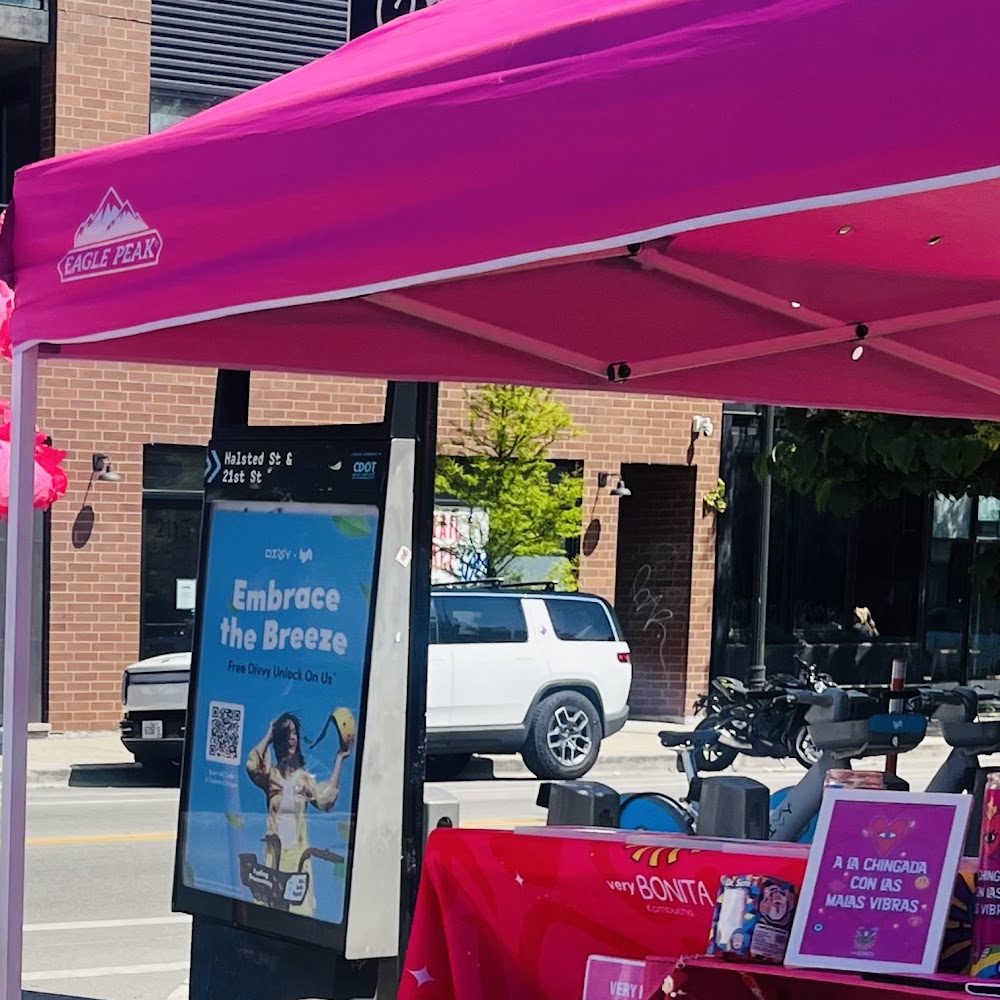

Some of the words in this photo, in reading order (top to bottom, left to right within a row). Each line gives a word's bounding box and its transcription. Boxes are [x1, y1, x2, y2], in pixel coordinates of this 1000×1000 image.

[64, 248, 111, 275] EAGLE
[112, 237, 156, 265] PEAK
[224, 451, 264, 466] Halsted
[269, 451, 281, 466] St
[286, 452, 293, 466] &
[353, 461, 377, 473] CDOT
[222, 469, 245, 484] 21st
[250, 470, 262, 484] St
[232, 578, 341, 612] Embrace
[220, 616, 257, 650] the
[262, 619, 348, 655] Breeze
[228, 660, 246, 675] Free
[248, 663, 272, 679] Divvy
[273, 667, 303, 681] Unlock
[305, 670, 318, 683] On
[833, 856, 843, 869] A
[846, 857, 859, 870] LA
[863, 858, 927, 875] CHINGADA
[606, 880, 635, 896] very
[635, 874, 715, 908] BONITA
[850, 876, 877, 890] CON
[880, 878, 903, 892] LAS
[825, 893, 866, 909] MALAS
[870, 896, 920, 913] VIBRAS
[610, 980, 637, 999] VERY
